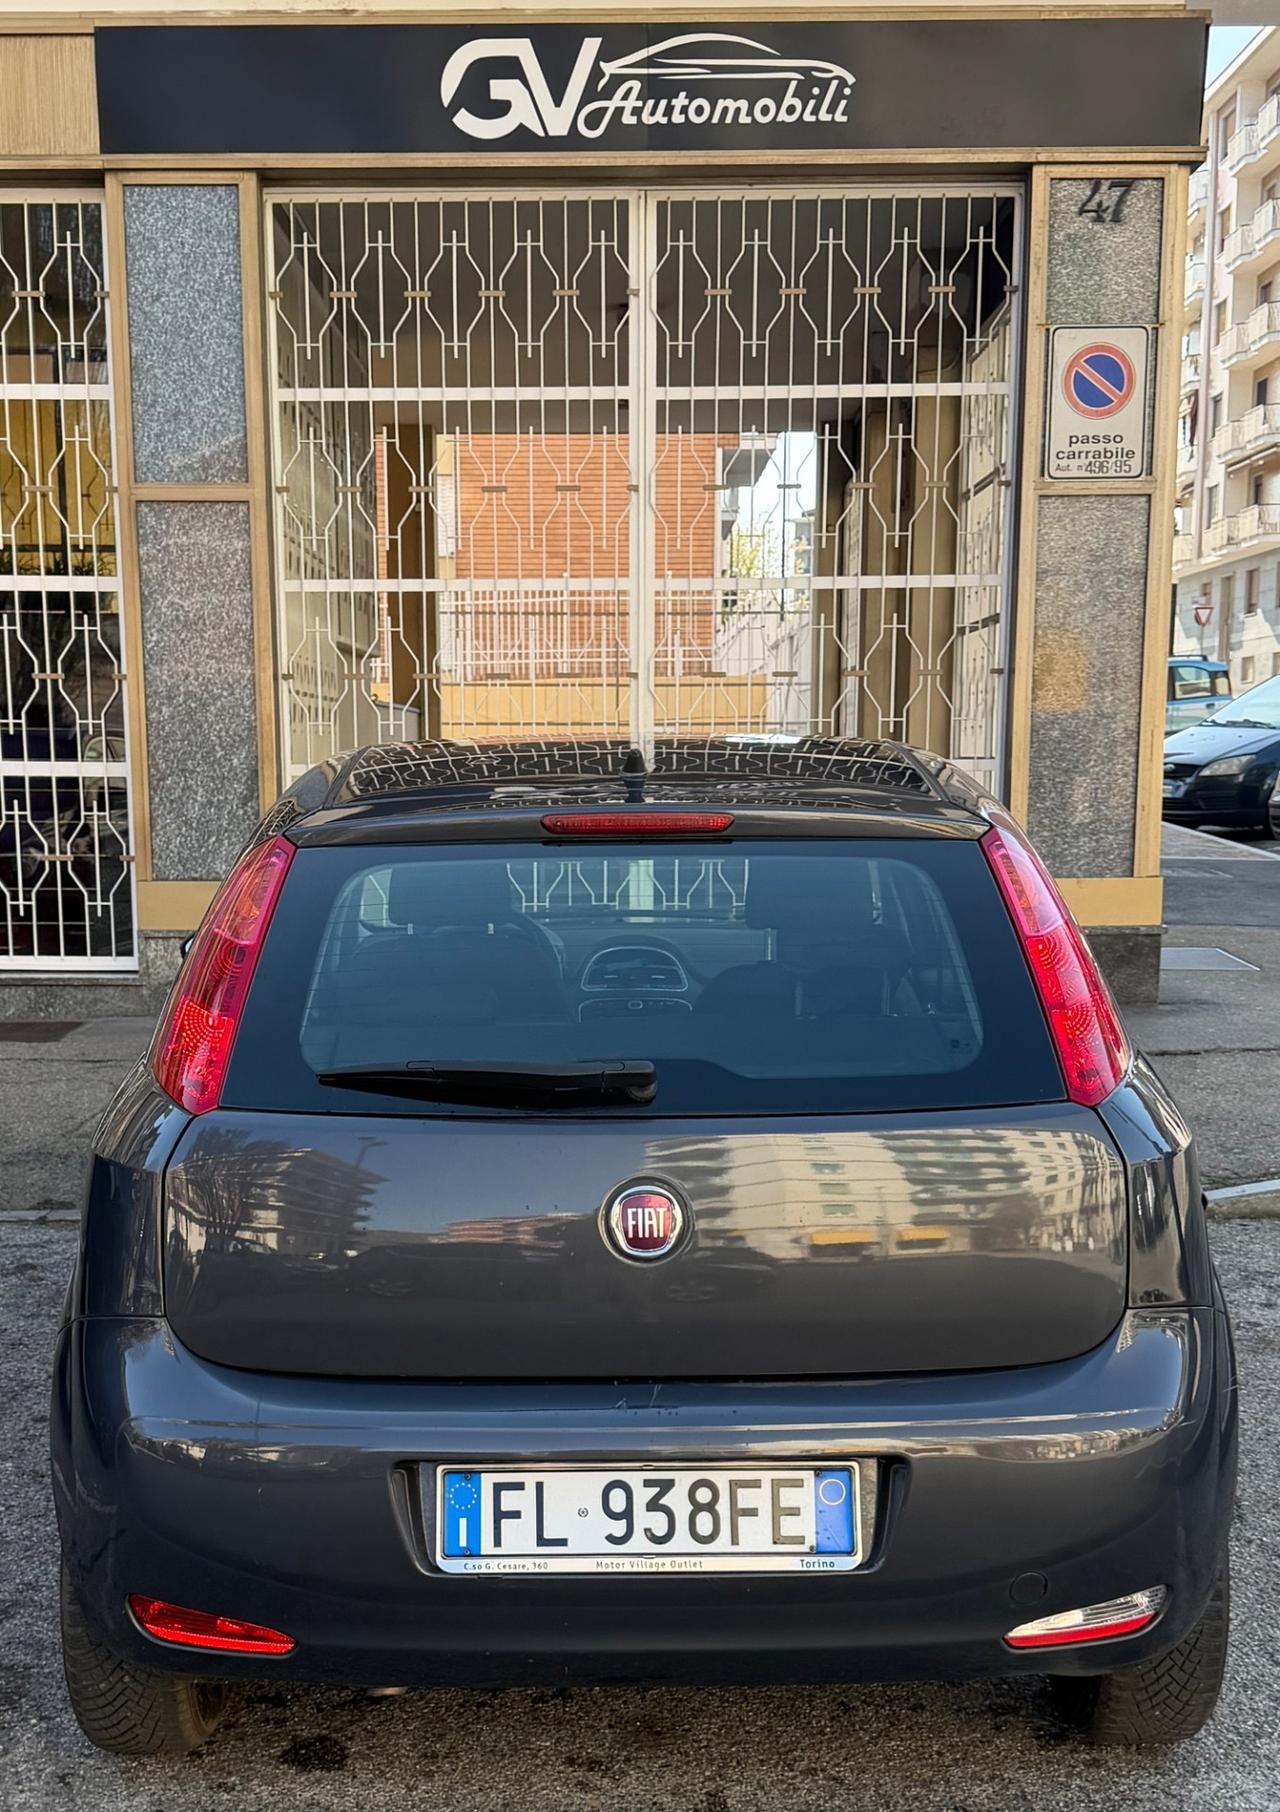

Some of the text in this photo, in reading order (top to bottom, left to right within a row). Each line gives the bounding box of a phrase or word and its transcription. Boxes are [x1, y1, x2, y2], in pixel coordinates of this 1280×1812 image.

[441, 37, 854, 139] GV Automobili
[1078, 178, 1136, 223] 47
[1068, 434, 1124, 447] passo
[1055, 447, 1136, 460] carrabile
[1055, 463, 1073, 473] Aut.
[627, 1207, 668, 1239] FIAT
[492, 1480, 569, 1548] FL
[463, 1561, 549, 1572] C.so G. Cesare, 360
[596, 1560, 703, 1571] Motor Village Outlet
[800, 1559, 836, 1569] Torino
